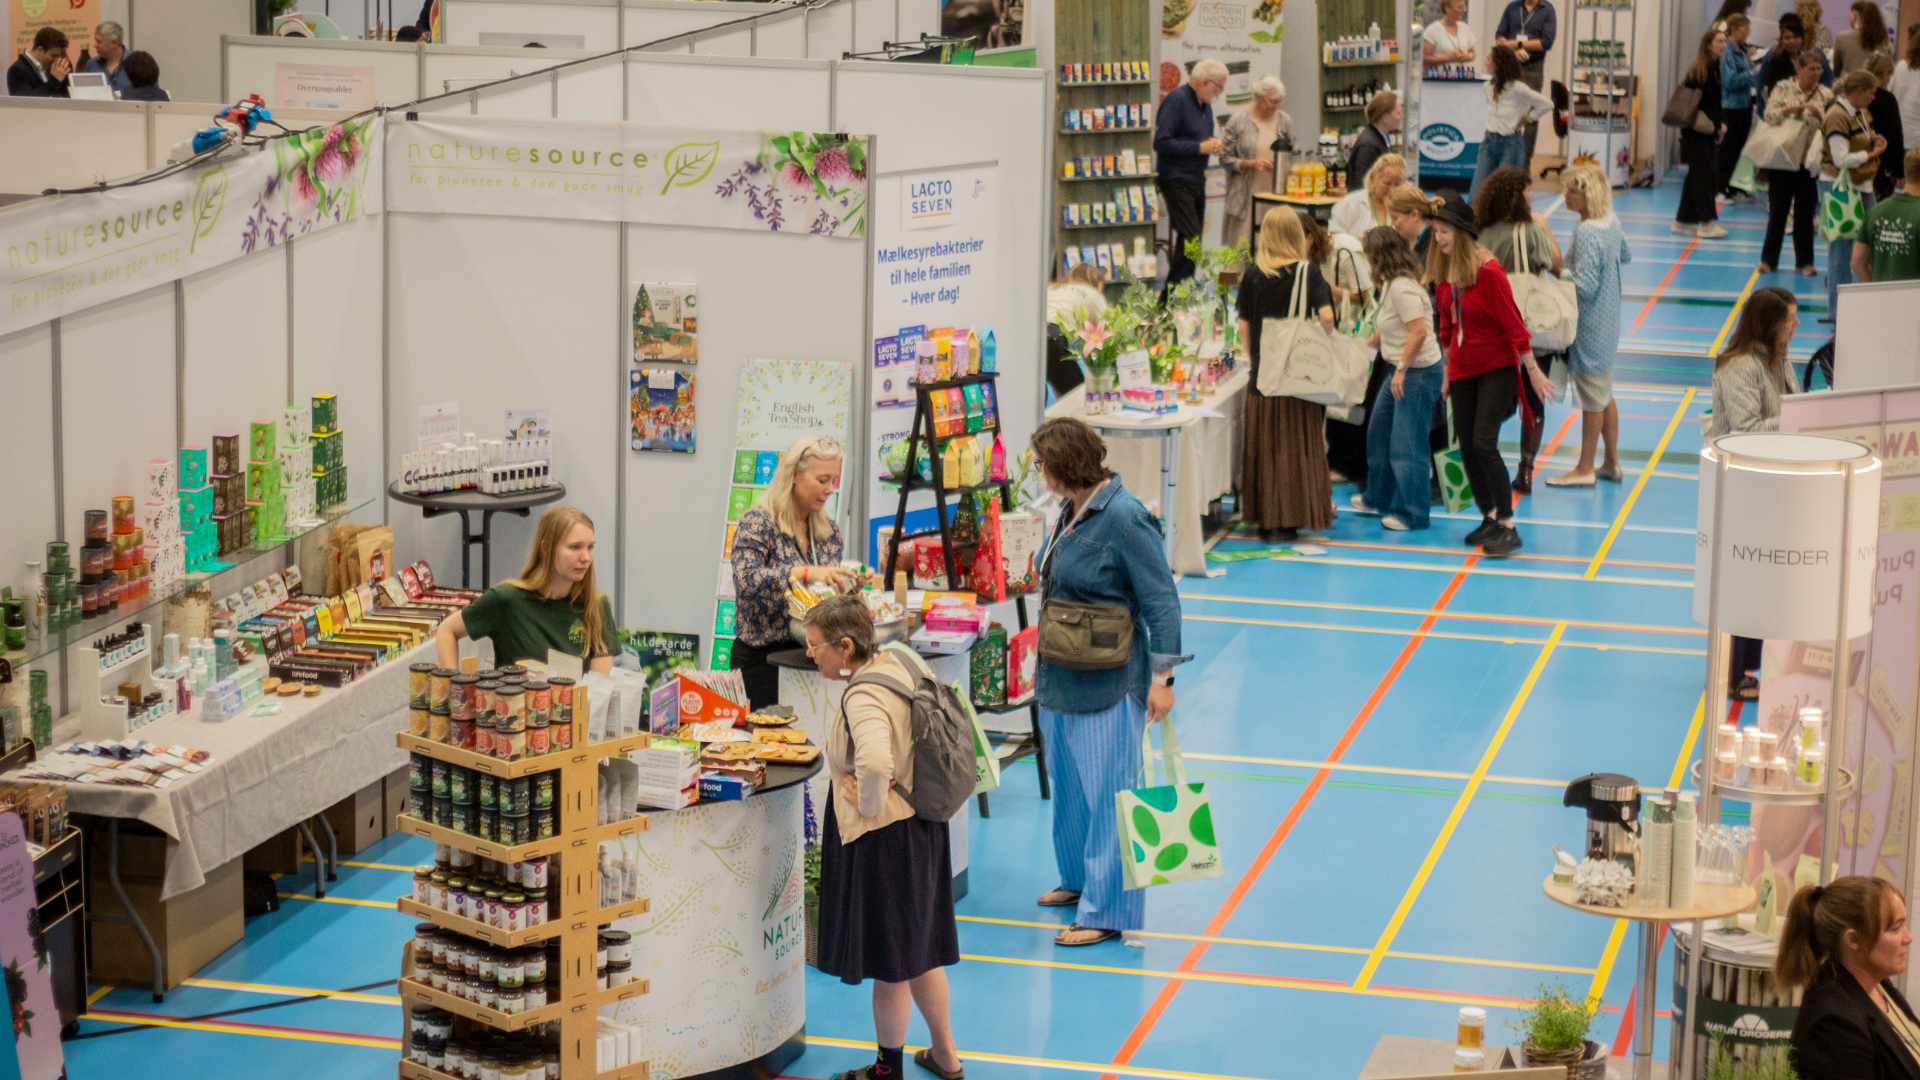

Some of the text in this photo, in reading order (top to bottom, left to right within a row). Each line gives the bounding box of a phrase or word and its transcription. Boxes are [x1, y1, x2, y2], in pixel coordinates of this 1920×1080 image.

[297, 84, 353, 94] Overgangsalder
[408, 140, 649, 169] naturesource
[410, 173, 643, 197] for planeten & den gode smag
[911, 180, 952, 198] LACTO
[911, 198, 952, 214] SEVEN
[7, 199, 184, 271] naturesource
[877, 237, 984, 264] Mælkesyrebakterier
[11, 248, 179, 314] for planeten & den gode smag
[890, 262, 971, 286] til hele familien
[911, 291, 936, 306] Hver
[938, 285, 960, 305] dag!
[877, 344, 898, 355] LACTO
[877, 352, 898, 362] SEVEN
[773, 402, 815, 416] English
[769, 413, 819, 428] Tea Shop
[881, 430, 912, 442] STRONG
[1733, 544, 1829, 566] NYHEDER
[630, 636, 692, 651] hildegarde
[654, 648, 692, 658] de Bingen
[291, 671, 318, 680] lifefood
[0, 864, 14, 875] aste
[1, 876, 23, 893] herbal
[1, 886, 26, 903] wonder
[1706, 1021, 1793, 1040] NATUR DROGERIE
